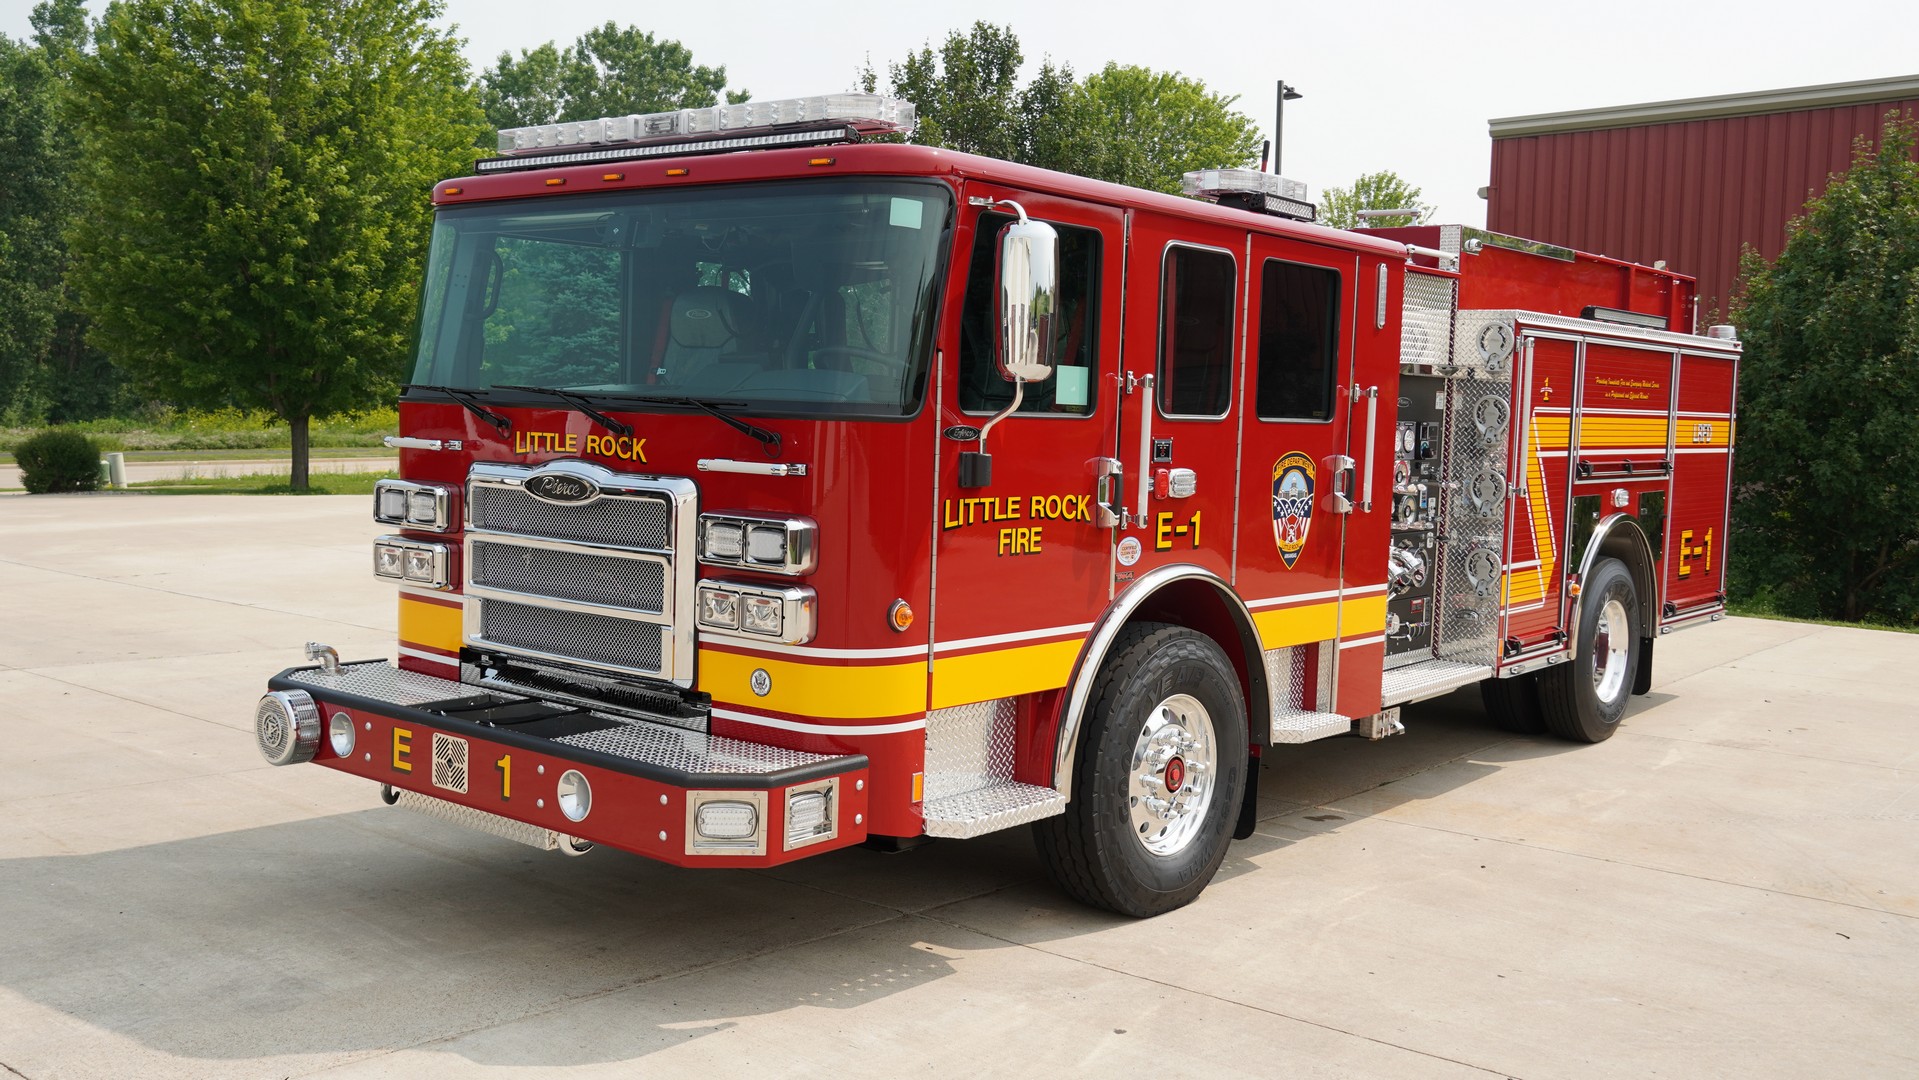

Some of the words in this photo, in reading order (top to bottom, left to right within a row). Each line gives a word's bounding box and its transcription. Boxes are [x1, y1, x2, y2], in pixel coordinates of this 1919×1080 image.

[515, 430, 577, 454] LITTLE
[586, 434, 647, 464] ROCK
[1692, 423, 1712, 443] LRFD
[540, 476, 580, 496] Pierce
[943, 496, 1021, 530] LITTLE
[1030, 494, 1091, 522] ROCK
[998, 526, 1043, 557] FIRE
[1155, 510, 1201, 552] E-1
[1678, 526, 1713, 579] E-1
[392, 727, 413, 775] E
[495, 754, 511, 801] 1
